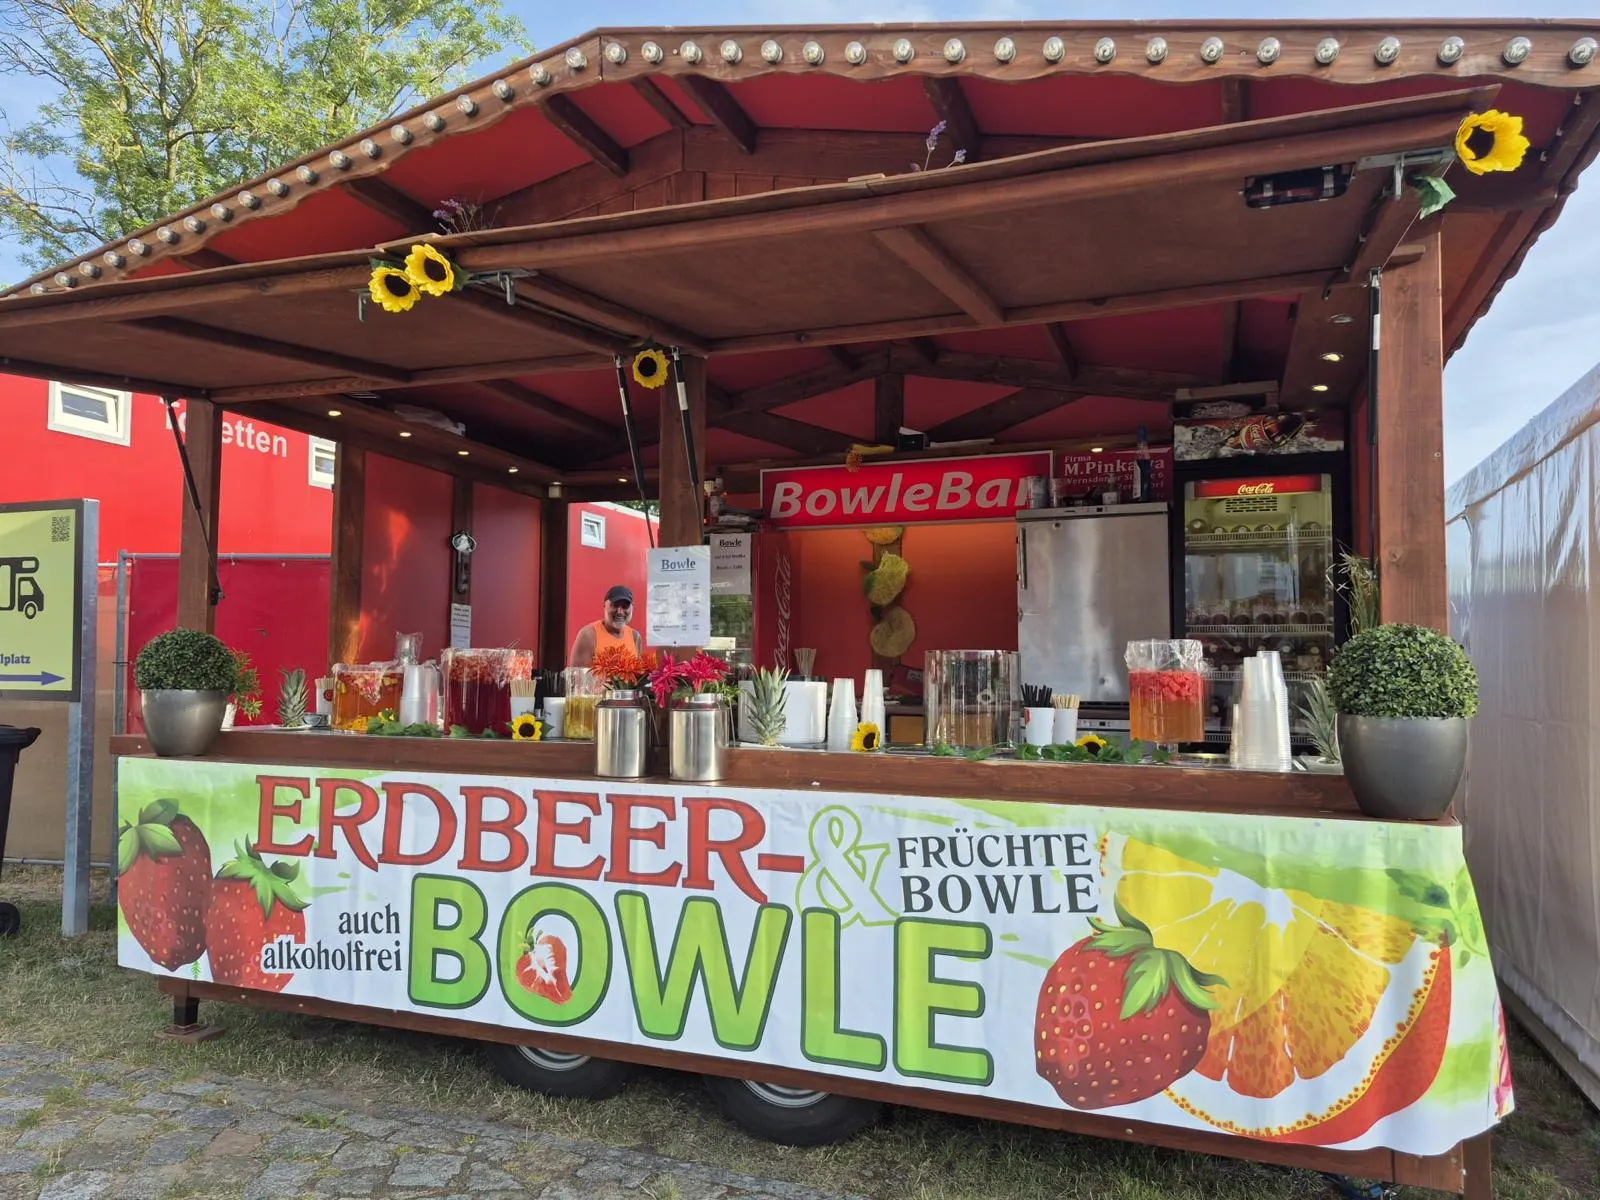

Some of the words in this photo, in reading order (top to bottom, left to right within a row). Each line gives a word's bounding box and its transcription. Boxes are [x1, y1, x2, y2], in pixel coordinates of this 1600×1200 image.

[160, 396, 288, 457] Tetten
[1064, 455, 1092, 463] Firma
[1064, 459, 1165, 476] M.Pinkaa
[770, 470, 1029, 519] BowleBar
[661, 557, 696, 570] Bowle
[251, 774, 805, 904] ERDBEER-
[897, 827, 1092, 868] FRÜCHTE
[900, 874, 1098, 914] BOWLE
[338, 903, 401, 935] auch
[263, 939, 402, 972] alkoholfrei
[406, 872, 994, 1086] BOWLE
